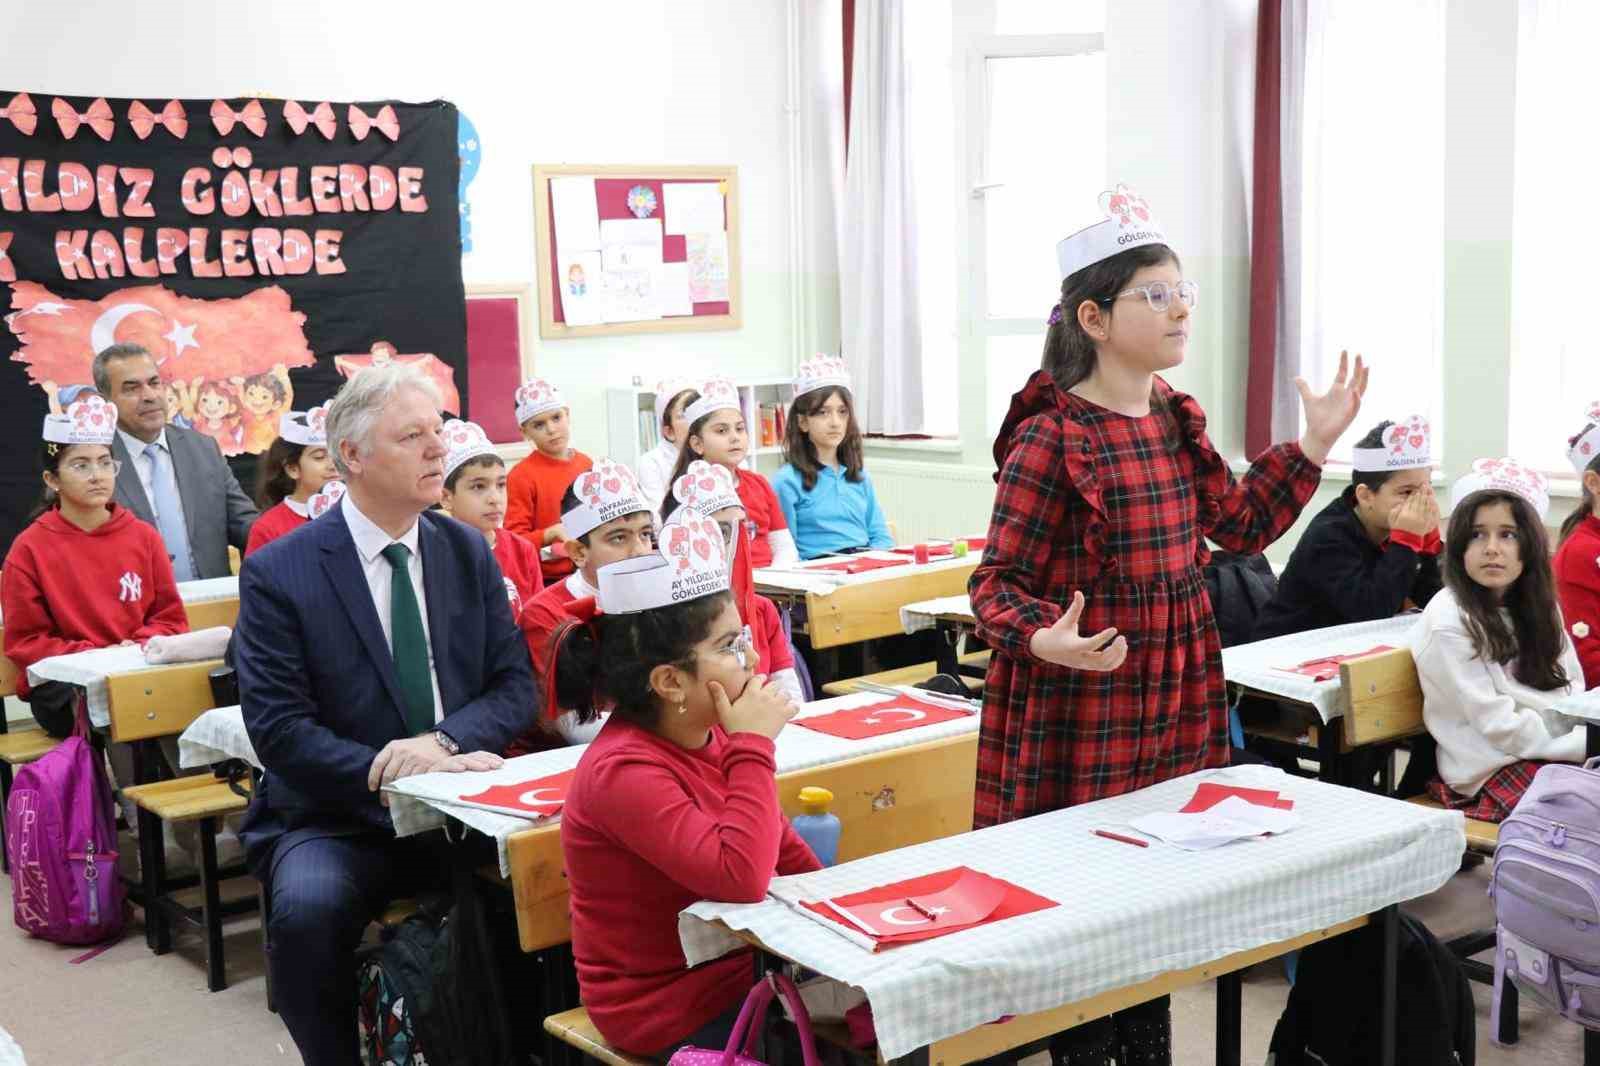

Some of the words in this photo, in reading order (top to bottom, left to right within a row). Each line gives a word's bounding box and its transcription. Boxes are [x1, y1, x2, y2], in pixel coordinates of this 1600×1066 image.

[181, 146, 428, 217] GÖKLERDE
[55, 226, 346, 280] KALPLERDE
[672, 580, 682, 590] AY
